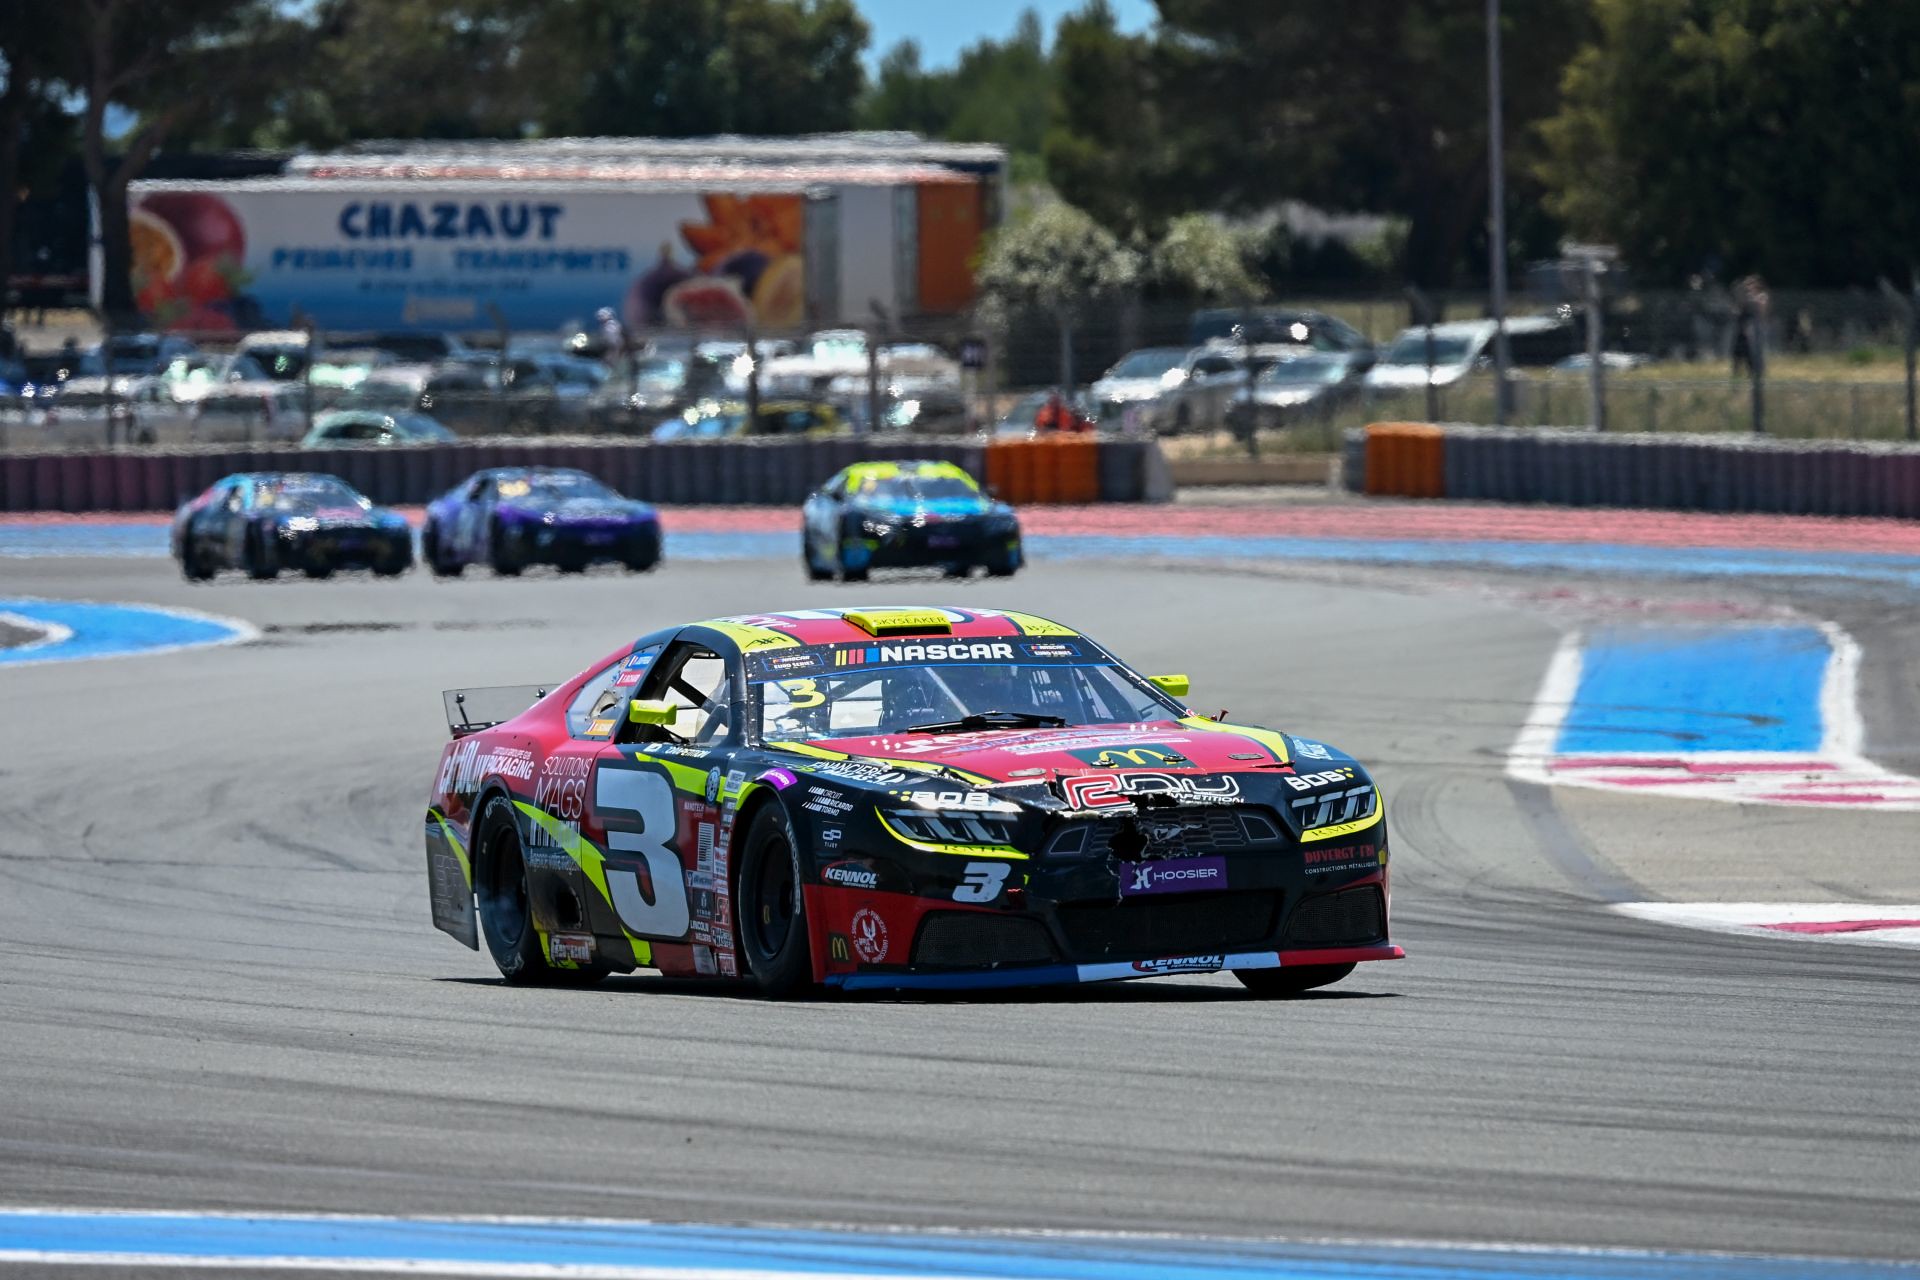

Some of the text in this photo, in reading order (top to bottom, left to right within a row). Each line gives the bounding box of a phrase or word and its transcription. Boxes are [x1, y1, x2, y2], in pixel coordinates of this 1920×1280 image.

[340, 203, 563, 239] CHAZAUT
[881, 643, 1014, 662] NASCAR
[779, 678, 826, 709] 3
[486, 755, 535, 781] PACKAGING
[541, 757, 593, 778] SOLUTIONS
[534, 777, 586, 819] MAGS
[822, 788, 844, 800] CIRCUIT
[820, 806, 840, 817] TORMO
[829, 799, 854, 812] RICARDO
[596, 767, 690, 938] 3
[825, 867, 878, 885] KENNOL
[1153, 868, 1218, 881] HOOSIER
[1304, 864, 1347, 875] CONSTRUCTIONS
[952, 861, 1012, 903] 3
[1140, 954, 1222, 968] KENNOL
